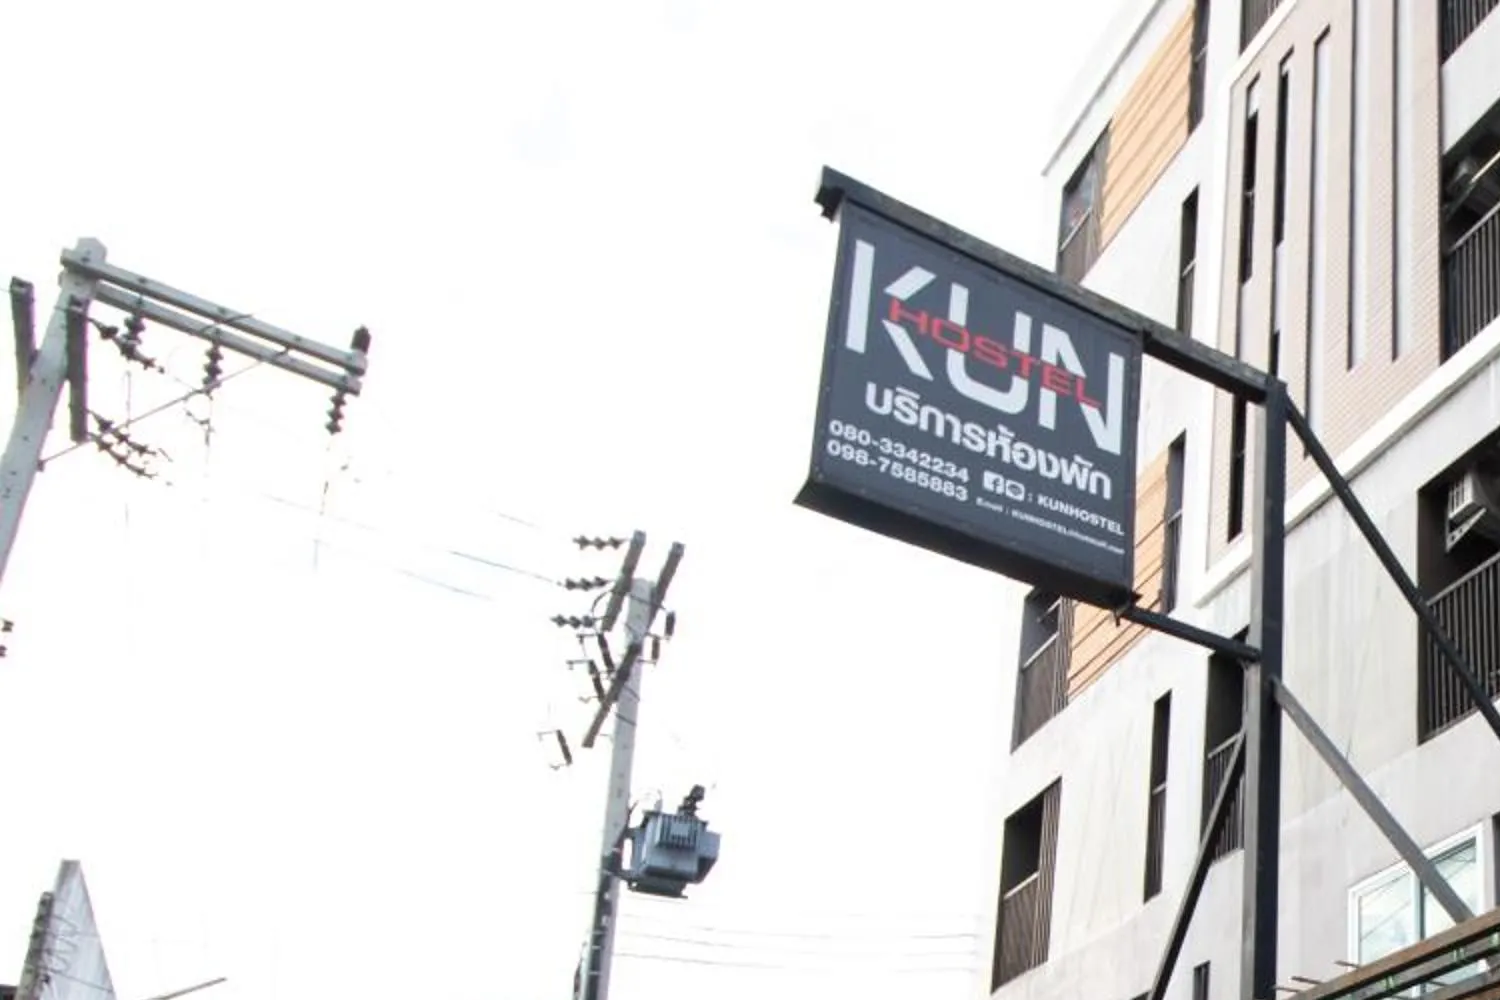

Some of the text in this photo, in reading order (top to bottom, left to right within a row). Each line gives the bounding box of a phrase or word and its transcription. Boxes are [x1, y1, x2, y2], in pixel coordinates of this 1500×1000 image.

[845, 239, 1125, 456] KUN
[888, 296, 1102, 409] HOSTEL
[829, 419, 969, 483] 080-3342234
[865, 382, 1112, 500] บริการห้องพัก
[1037, 493, 1125, 537] KUNHOSTEL
